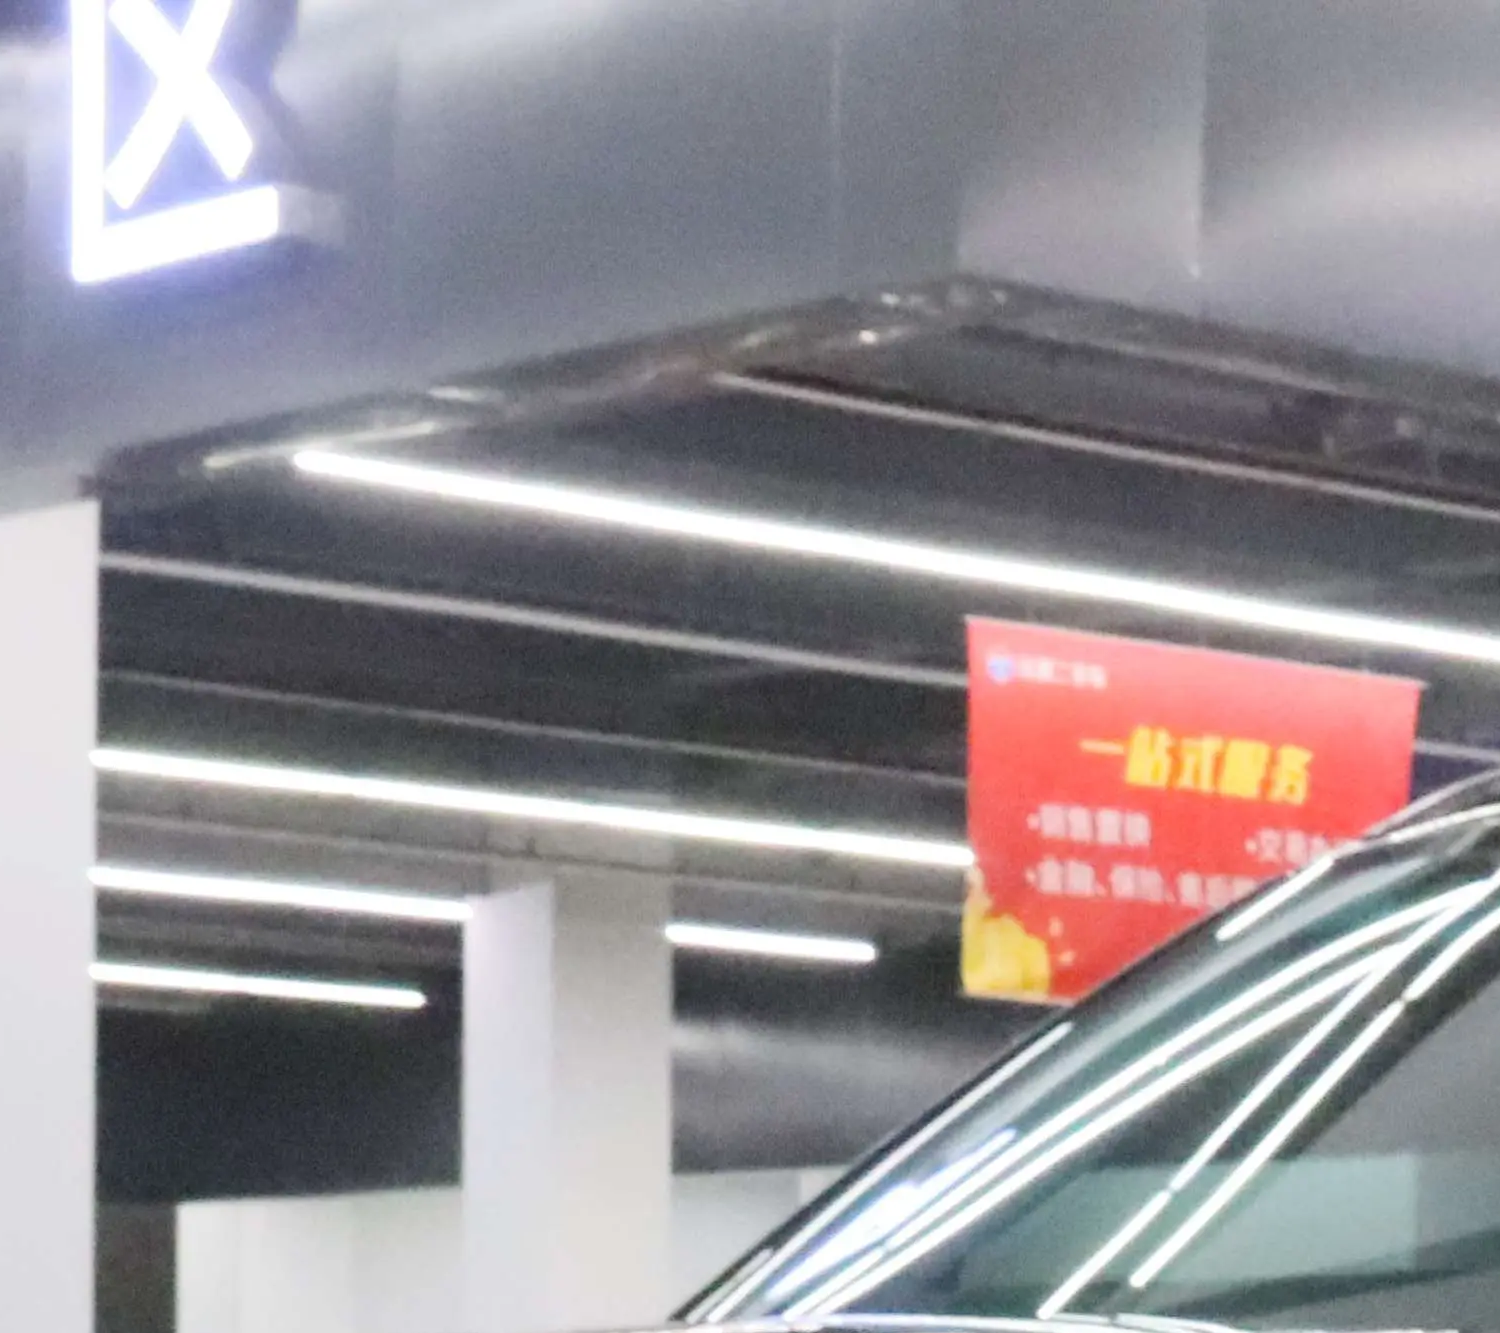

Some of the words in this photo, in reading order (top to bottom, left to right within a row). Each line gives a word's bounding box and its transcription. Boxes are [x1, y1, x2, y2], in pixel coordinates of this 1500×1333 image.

[1078, 725, 1313, 804] 一站式服务
